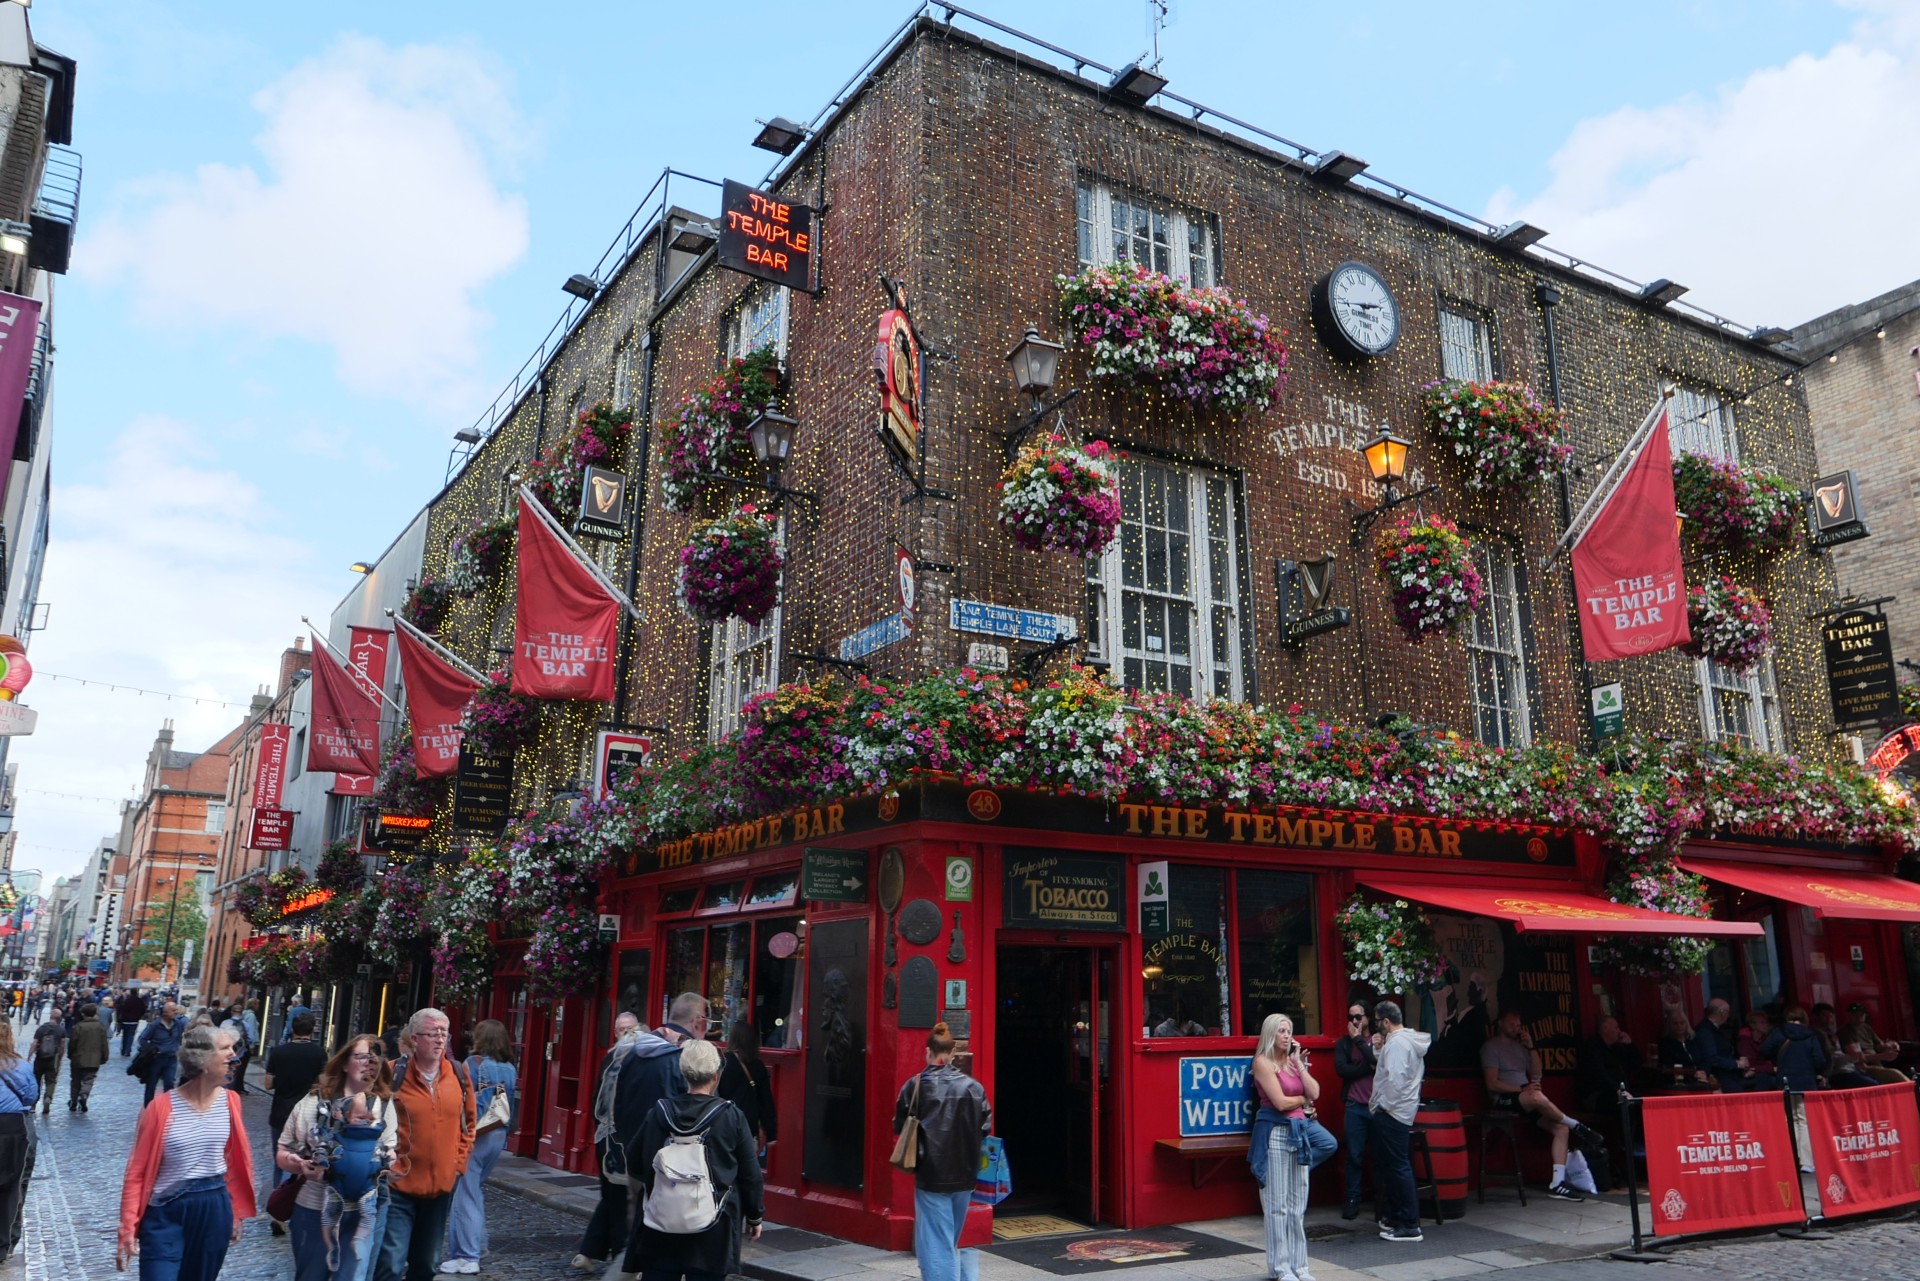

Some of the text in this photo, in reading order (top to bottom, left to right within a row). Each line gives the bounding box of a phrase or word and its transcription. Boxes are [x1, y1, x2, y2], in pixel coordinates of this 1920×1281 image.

[749, 193, 790, 223] THE
[727, 210, 808, 252] TEMPLE
[747, 244, 788, 272] BAR
[1359, 319, 1373, 331] TIME
[1323, 394, 1370, 430] THE
[1268, 422, 1369, 456] TEMPLE
[580, 521, 623, 538] GUINNESS
[1818, 526, 1862, 544] GUINNESS
[1615, 575, 1654, 594] THE
[1587, 582, 1676, 615] TEMPLE
[985, 606, 1022, 623] TEMPLE
[1026, 613, 1057, 630] THEAS
[1291, 611, 1335, 634] GUINNESS
[1614, 608, 1664, 630] BAR
[1843, 615, 1864, 625] THE
[547, 632, 584, 646] THE
[996, 621, 1021, 634] LANE
[1025, 626, 1057, 639] SOUTH
[1825, 621, 1885, 641] TEMPLE
[521, 641, 608, 662] TEMPLE
[1841, 637, 1874, 652] BAR
[542, 661, 587, 677] BAR
[333, 726, 356, 736] THE
[315, 733, 373, 750] TEMPLE
[271, 742, 283, 764] THE
[330, 746, 361, 759] BAR
[473, 755, 502, 769] BAR
[973, 794, 994, 813] 48
[257, 818, 288, 827] TEMPLE
[266, 811, 281, 819] THE
[381, 815, 430, 829] WHISKEY SHOP
[262, 826, 279, 834] BAR
[656, 838, 694, 869] THE
[700, 818, 783, 861] TEMPLE
[793, 803, 845, 841] BAR
[1118, 802, 1208, 840] THE
[1224, 811, 1377, 850] TEMPLE
[1393, 826, 1463, 856] BAR
[1008, 856, 1058, 878] Importers
[1052, 875, 1108, 886] FINE SMOKING
[1022, 879, 1109, 915] TOBACCO
[1040, 908, 1116, 922] Always in Stock
[1175, 918, 1194, 928] THE
[1458, 923, 1484, 938] THE
[1143, 934, 1197, 963] TEMPLE
[1447, 936, 1496, 954] TEMPLE
[1544, 951, 1569, 971] THE
[1519, 971, 1572, 993] EMPEROR
[1558, 993, 1571, 1013] OF
[1531, 1014, 1575, 1041] LIQUORS
[1191, 1062, 1253, 1091] POW
[1857, 1121, 1874, 1134] THE
[1708, 1130, 1730, 1145] THE
[1833, 1128, 1902, 1152] TEMPLE BAR
[1677, 1141, 1765, 1164] TEMPLE BAR
